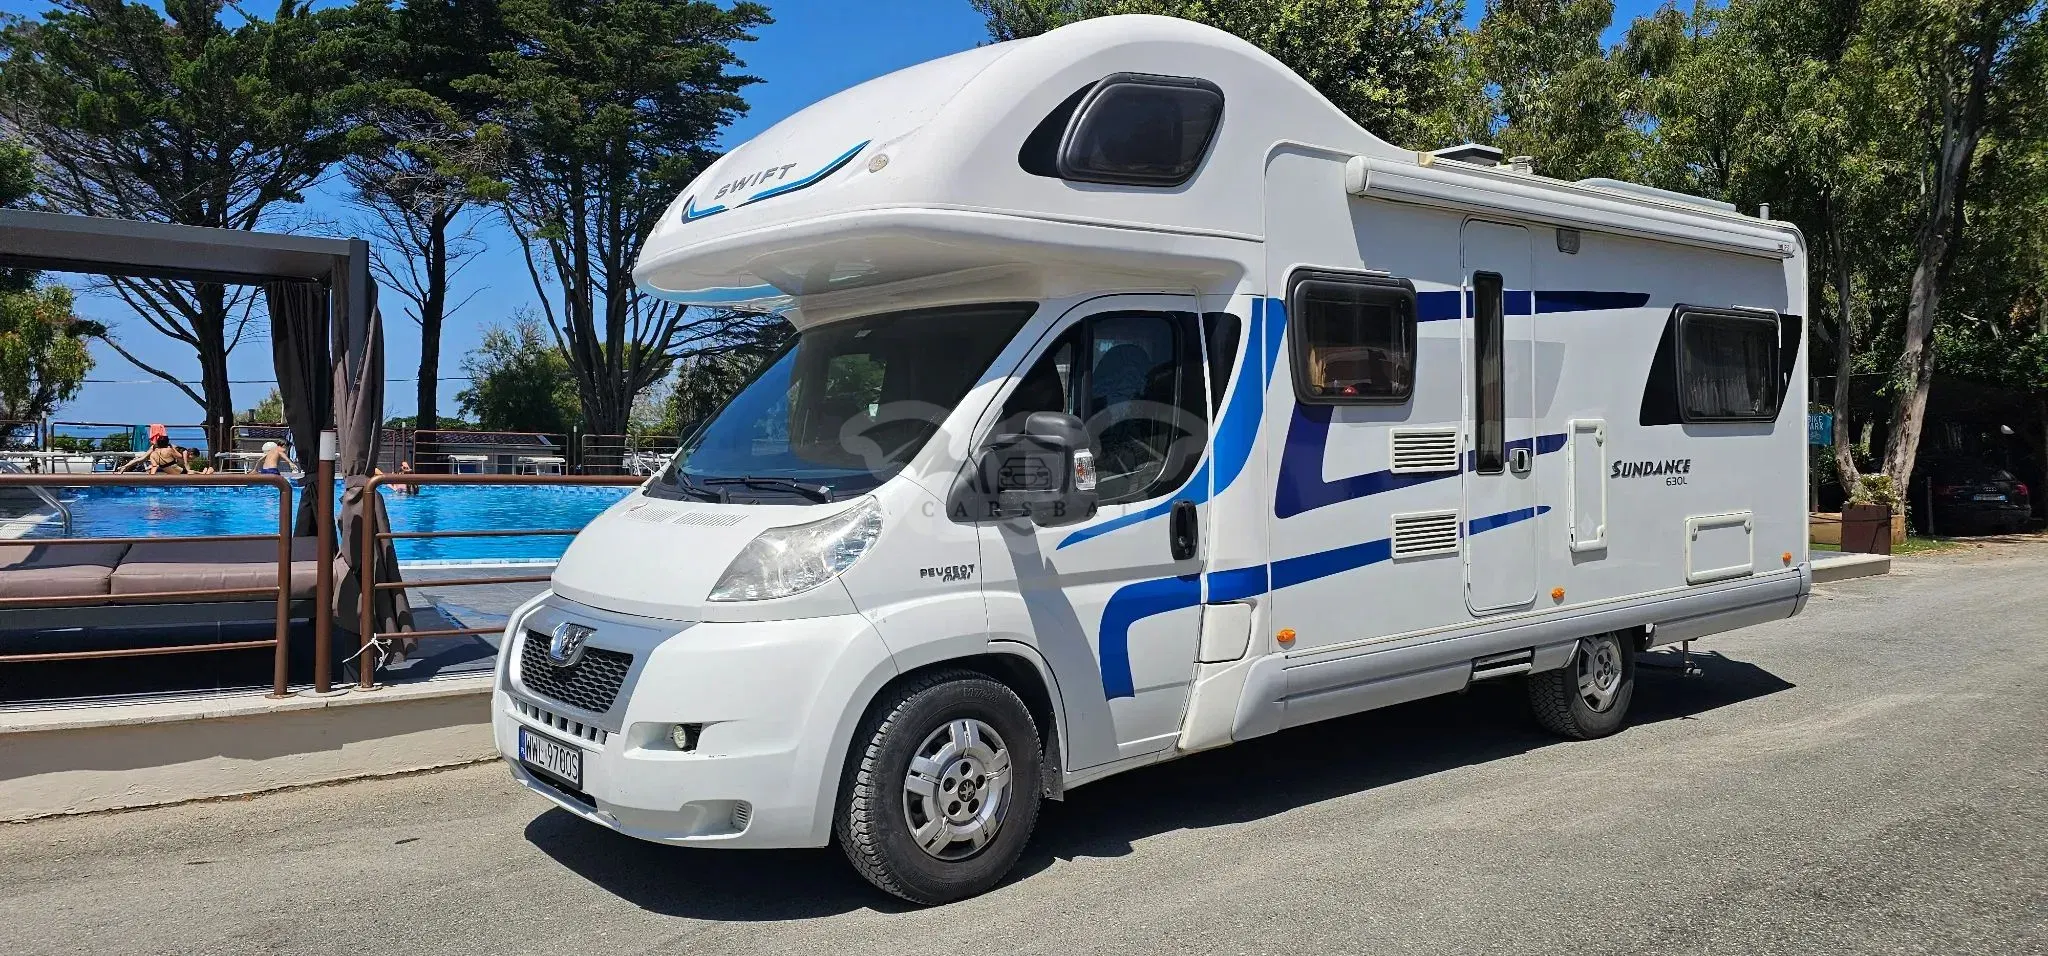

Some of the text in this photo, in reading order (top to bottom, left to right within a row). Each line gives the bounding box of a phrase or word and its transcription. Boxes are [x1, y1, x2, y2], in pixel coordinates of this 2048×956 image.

[714, 162, 798, 200] SWIFT
[1808, 422, 1824, 431] ARK
[1610, 459, 1691, 479] SUNDANCE
[1665, 476, 1688, 486] 630L
[919, 563, 975, 579] PEUGEOT
[525, 732, 545, 766] WWL
